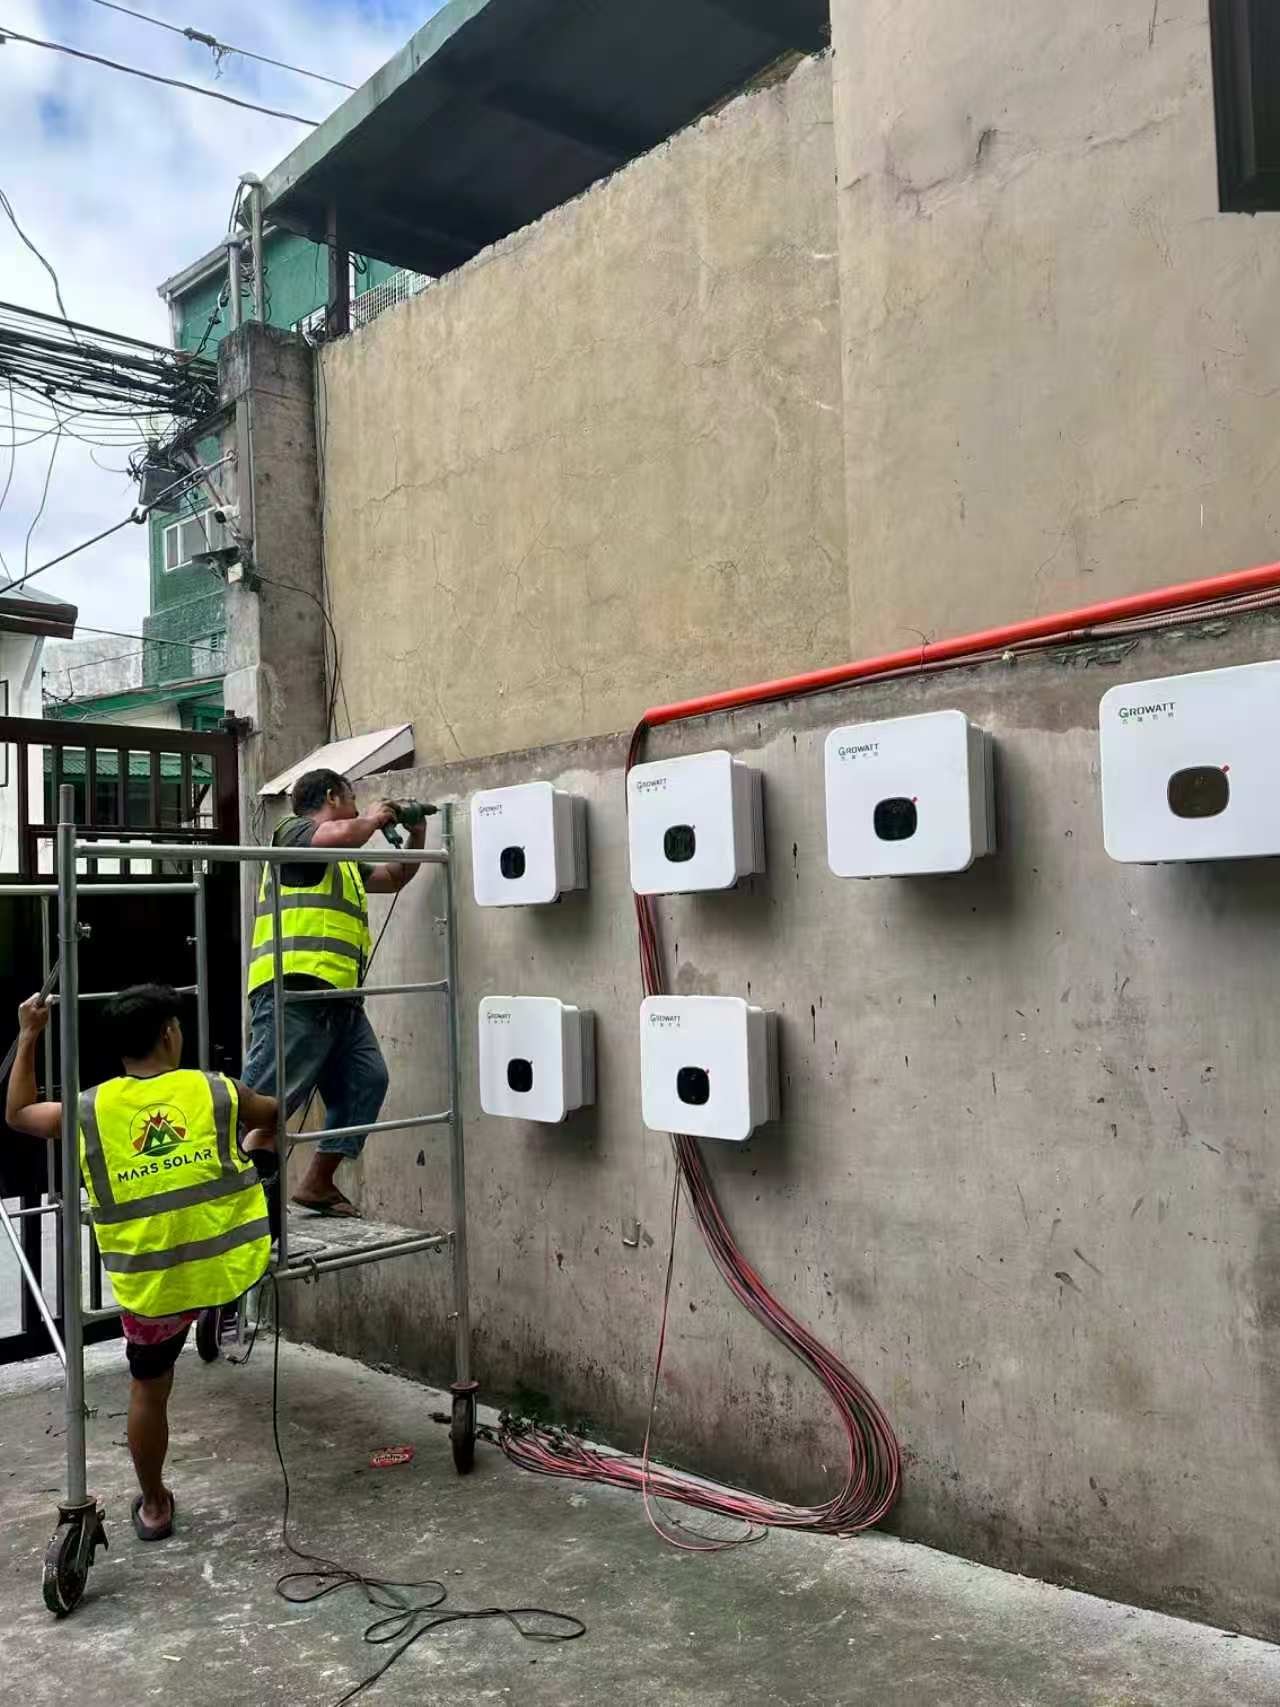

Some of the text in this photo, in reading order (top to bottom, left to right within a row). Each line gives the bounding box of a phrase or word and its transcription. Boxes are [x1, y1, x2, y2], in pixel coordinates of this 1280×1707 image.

[1119, 702, 1176, 718] GROWATT
[838, 742, 879, 756] GROWATT
[117, 1148, 213, 1182] MARS SOLAR
